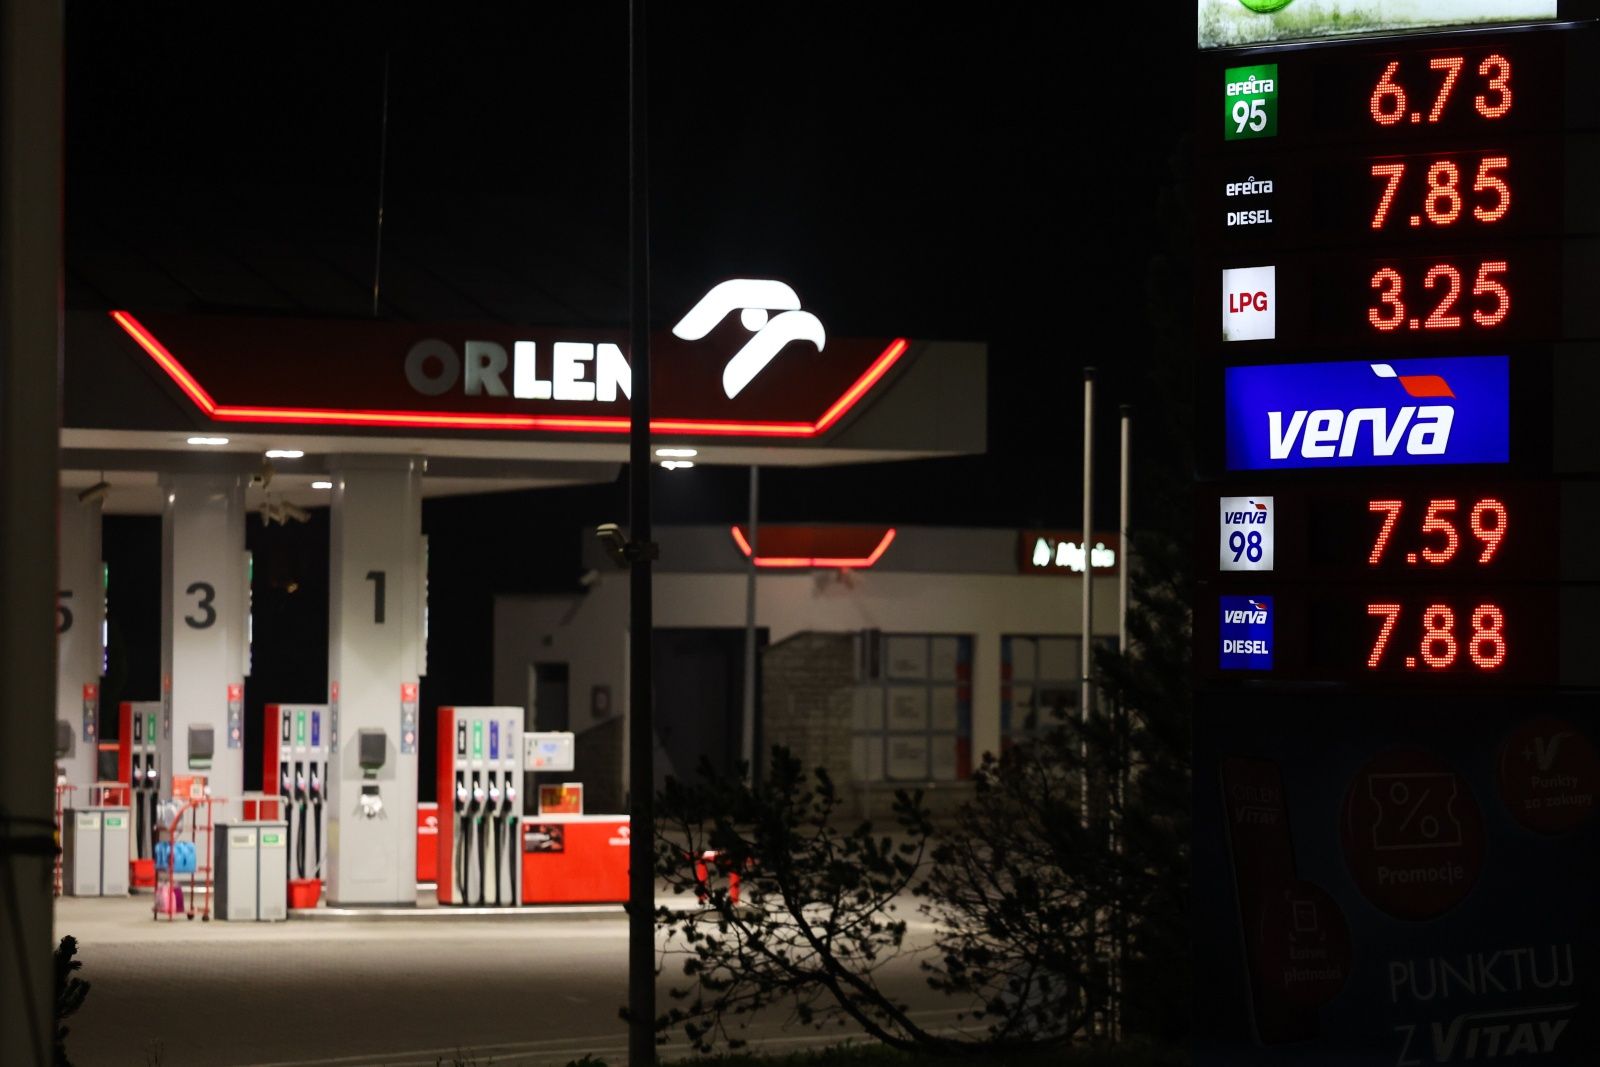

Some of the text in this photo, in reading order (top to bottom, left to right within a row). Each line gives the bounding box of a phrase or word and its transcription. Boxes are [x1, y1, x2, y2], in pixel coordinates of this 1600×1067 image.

[1370, 54, 1512, 125] 6.73
[1232, 99, 1267, 133] 95
[1371, 157, 1510, 228] 7.85
[1227, 210, 1273, 226] DIESEL
[1229, 291, 1268, 314] LPG
[1368, 261, 1510, 330] 3.25
[1267, 405, 1455, 460] verva
[1224, 510, 1268, 525] verva
[1368, 499, 1508, 564] 7.59
[1228, 531, 1263, 563] 98
[184, 581, 217, 629] 3
[365, 570, 386, 624] 1
[1224, 609, 1268, 625] verva
[1223, 639, 1269, 655] DIESEL
[1367, 603, 1507, 668] 7.88
[1377, 861, 1464, 885] Promocje
[1389, 944, 1576, 1003] PUNKTUJ
